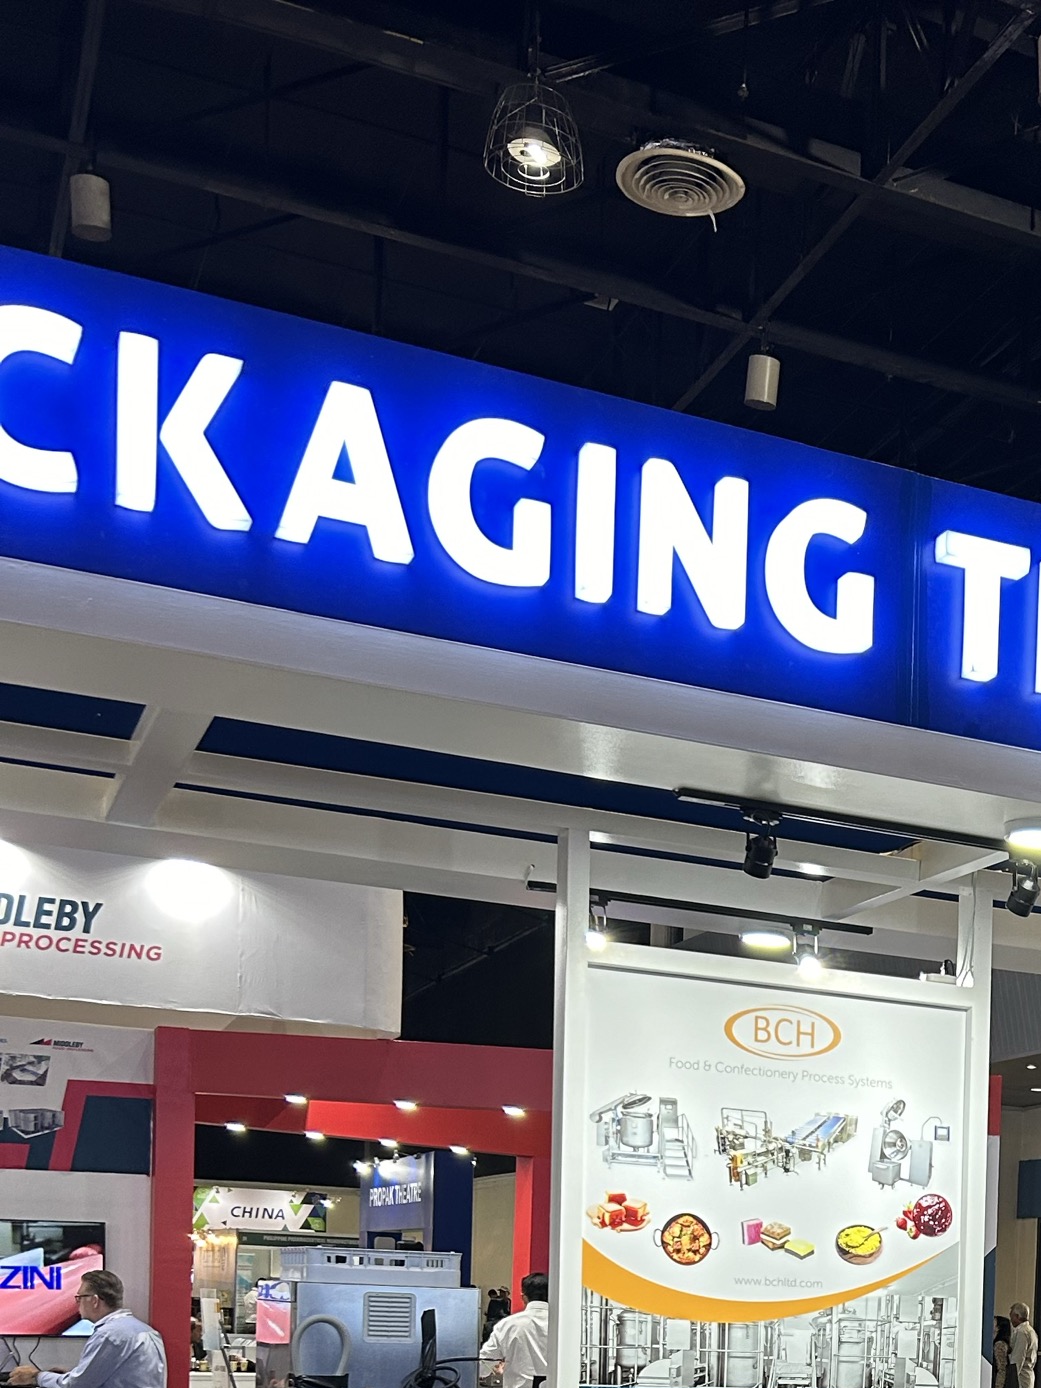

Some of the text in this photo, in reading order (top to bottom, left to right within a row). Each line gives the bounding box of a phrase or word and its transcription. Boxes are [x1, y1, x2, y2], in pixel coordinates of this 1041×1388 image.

[0, 303, 875, 656] CKAGING
[0, 931, 163, 962] PROCESSING
[753, 1015, 816, 1049] BCH
[669, 1056, 894, 1090] Food & Confectionery Process Systems
[369, 1181, 422, 1207] PROPAK THEATRE
[230, 1205, 286, 1220] CHINA
[0, 1265, 62, 1290] ZINI
[733, 1276, 823, 1289] www.bchltd.com
